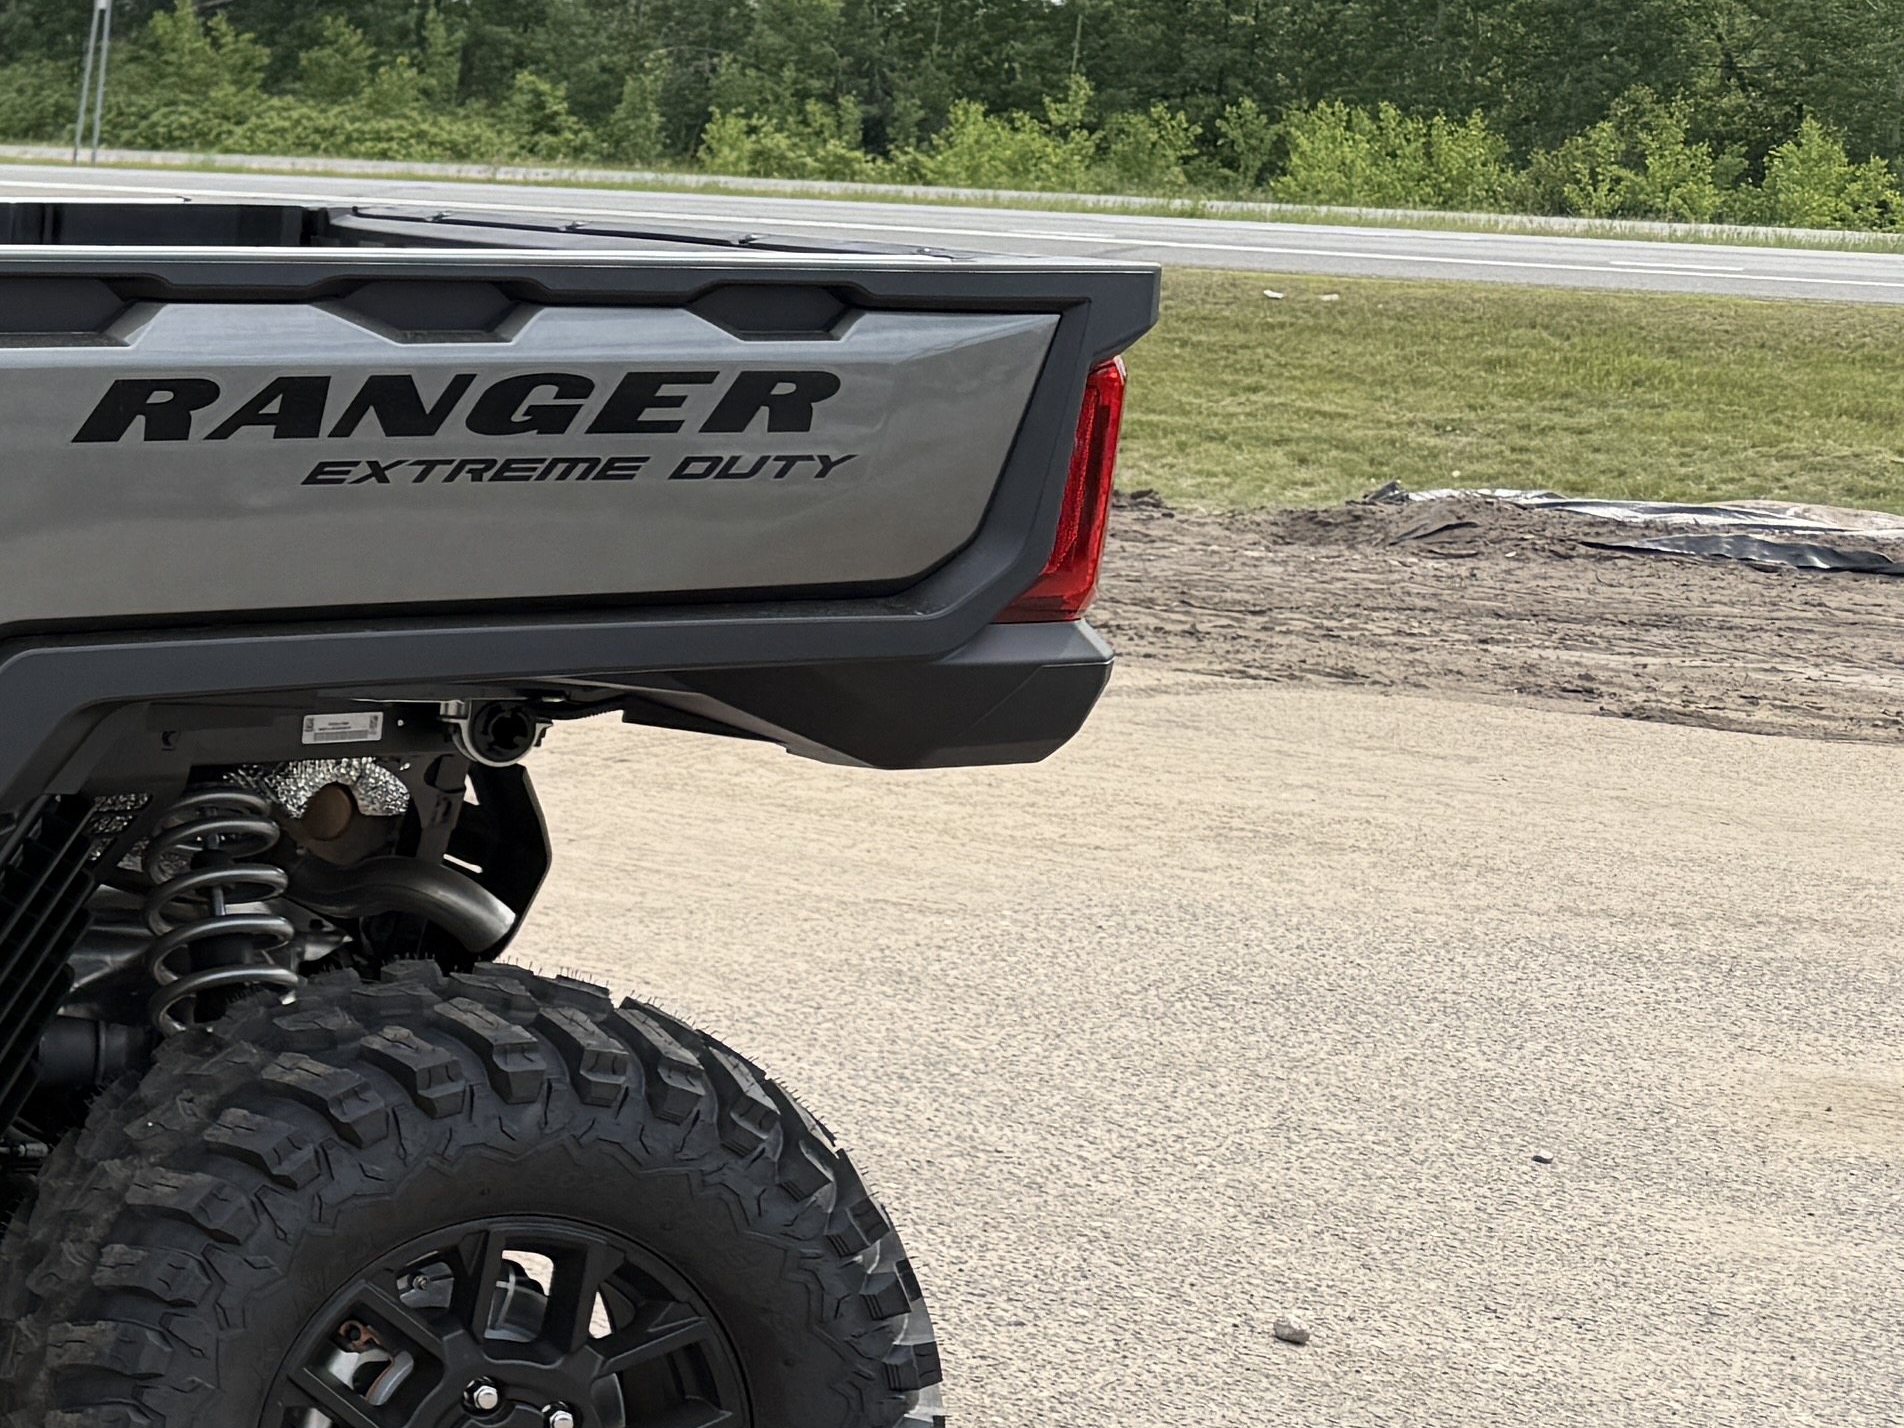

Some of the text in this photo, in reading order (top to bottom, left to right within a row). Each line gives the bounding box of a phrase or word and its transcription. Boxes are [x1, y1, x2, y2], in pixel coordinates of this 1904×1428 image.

[72, 370, 842, 443] RANGER
[300, 453, 859, 486] EXTREME DUTY
